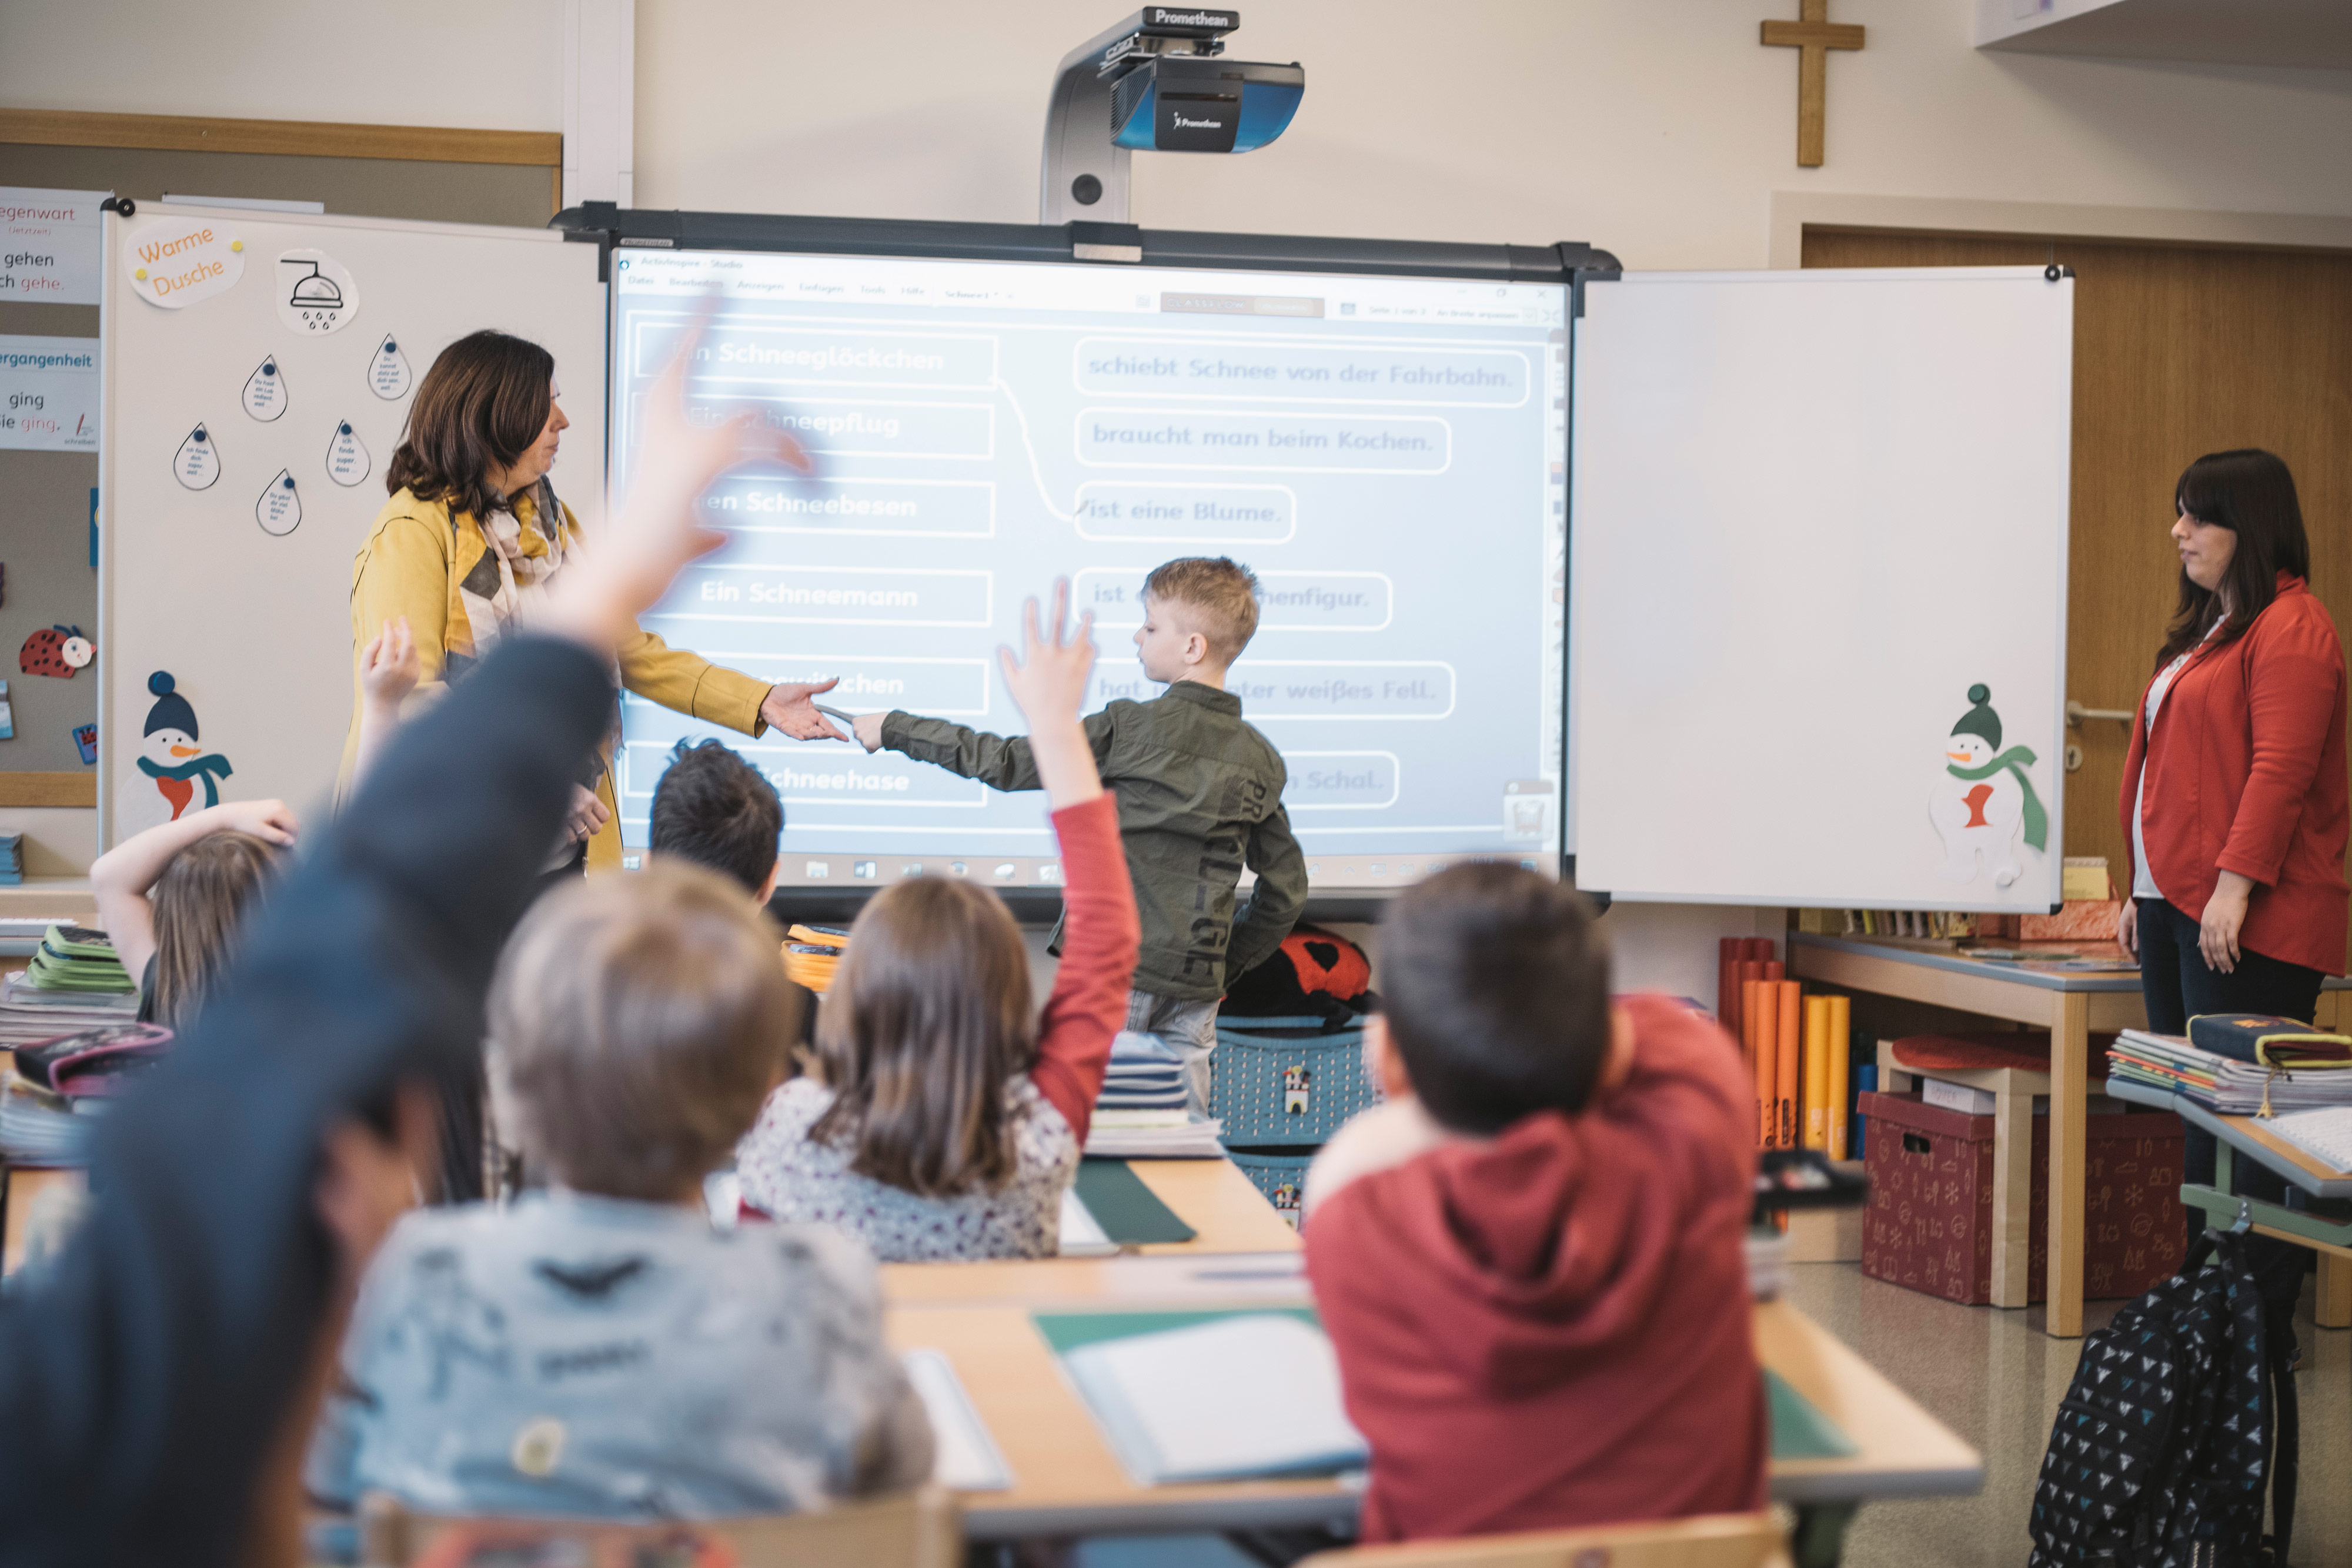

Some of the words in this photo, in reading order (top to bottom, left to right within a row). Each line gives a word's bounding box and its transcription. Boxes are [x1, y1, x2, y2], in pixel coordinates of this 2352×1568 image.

[1155, 9, 1228, 26] Promethean
[138, 229, 214, 263] Warme
[5, 251, 54, 268] gehen
[21, 276, 64, 292] gehe.
[153, 261, 224, 296] Dusche
[628, 276, 654, 285] Datei
[719, 342, 944, 371] Schneeglöckchen
[1088, 356, 1180, 378] schiebt
[1188, 359, 1277, 380] Schnee
[1287, 365, 1330, 382] von
[1339, 363, 1380, 383] der
[1391, 365, 1515, 388] Fahrbahn.
[9, 392, 44, 410] ging
[21, 415, 60, 433] ging.
[1093, 423, 1192, 446] braucht
[1203, 430, 1259, 447] man
[1268, 427, 1328, 449] beim
[1338, 430, 1434, 452] Kochen.
[746, 491, 917, 517] Schneebesen
[1089, 499, 1121, 519] ist
[1131, 501, 1184, 521] eine
[1193, 503, 1283, 523] Blume.
[701, 581, 740, 602] Ein
[749, 582, 918, 608] Schneemann
[1094, 583, 1125, 603] ist
[1100, 678, 1144, 697] hat
[1286, 679, 1374, 704] weißes
[1383, 680, 1436, 700] Fell.
[1307, 770, 1385, 791] Schal.
